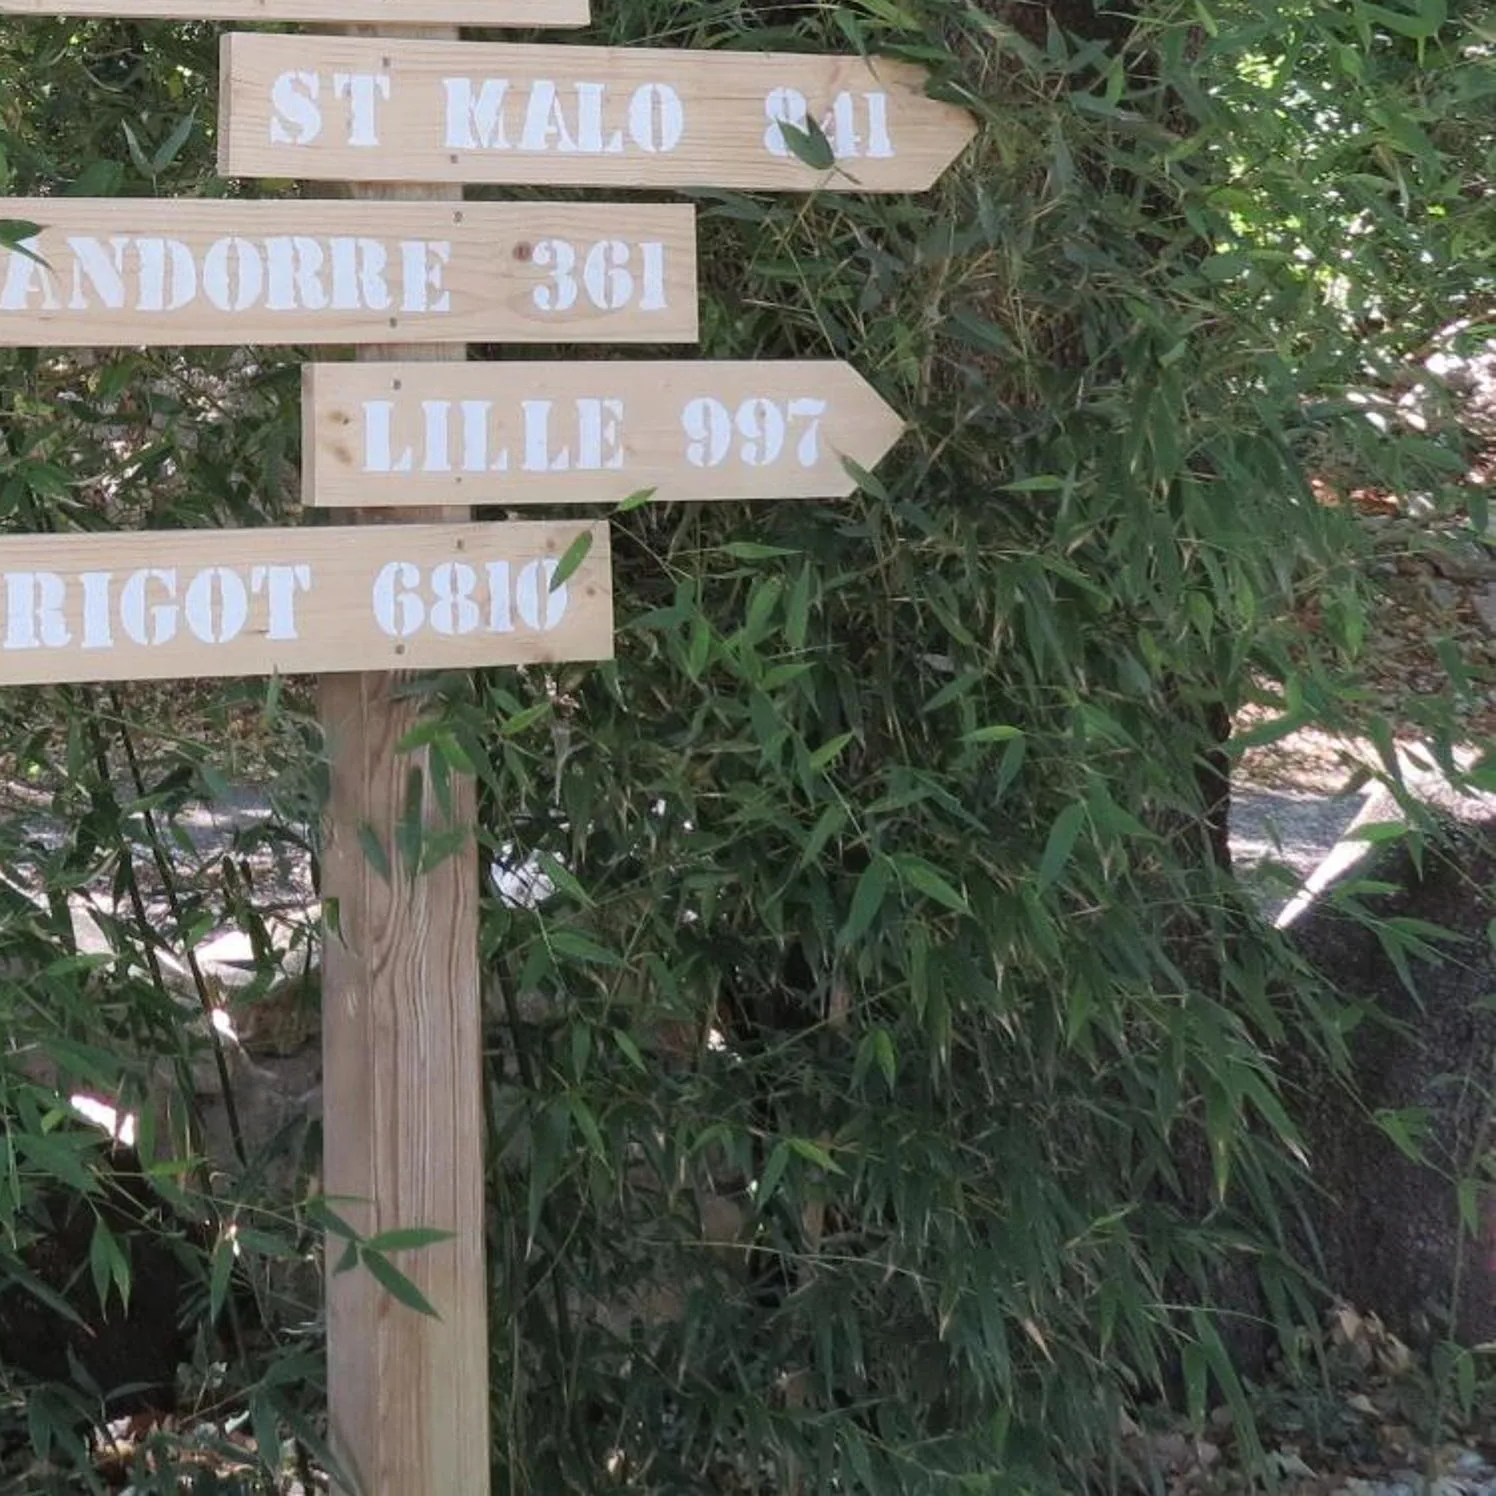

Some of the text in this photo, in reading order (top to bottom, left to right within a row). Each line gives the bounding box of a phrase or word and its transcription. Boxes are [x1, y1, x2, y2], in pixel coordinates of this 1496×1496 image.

[269, 69, 390, 148] ST
[442, 76, 686, 154] MALO
[530, 239, 667, 315] 361
[361, 396, 828, 474] LILLE 997
[371, 557, 571, 639] 6810
